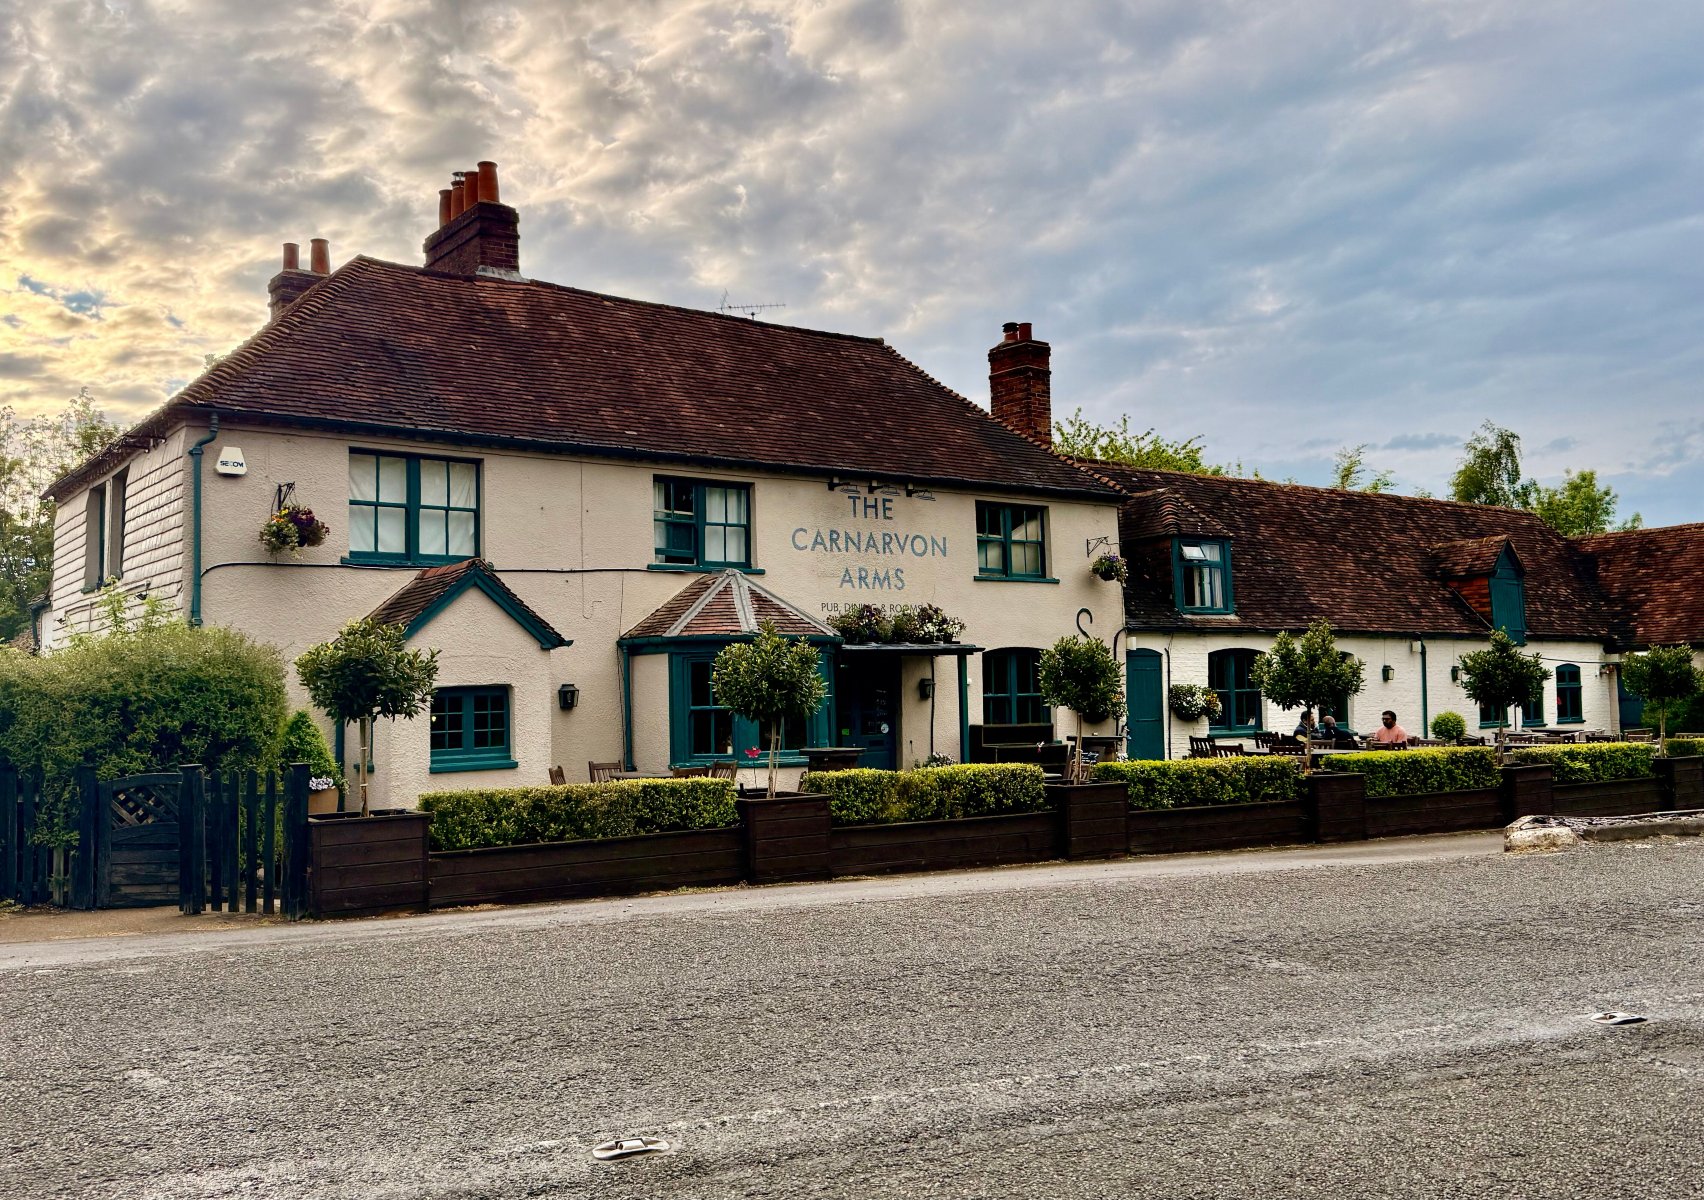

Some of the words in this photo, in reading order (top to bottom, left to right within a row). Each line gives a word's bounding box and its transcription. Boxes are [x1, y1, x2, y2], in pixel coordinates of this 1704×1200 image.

[847, 495, 893, 520] THE
[791, 527, 947, 558] CARNARVON
[839, 567, 906, 590] ARMS
[821, 602, 841, 615] PUB,
[844, 603, 877, 613] DINIG
[880, 603, 888, 613] &
